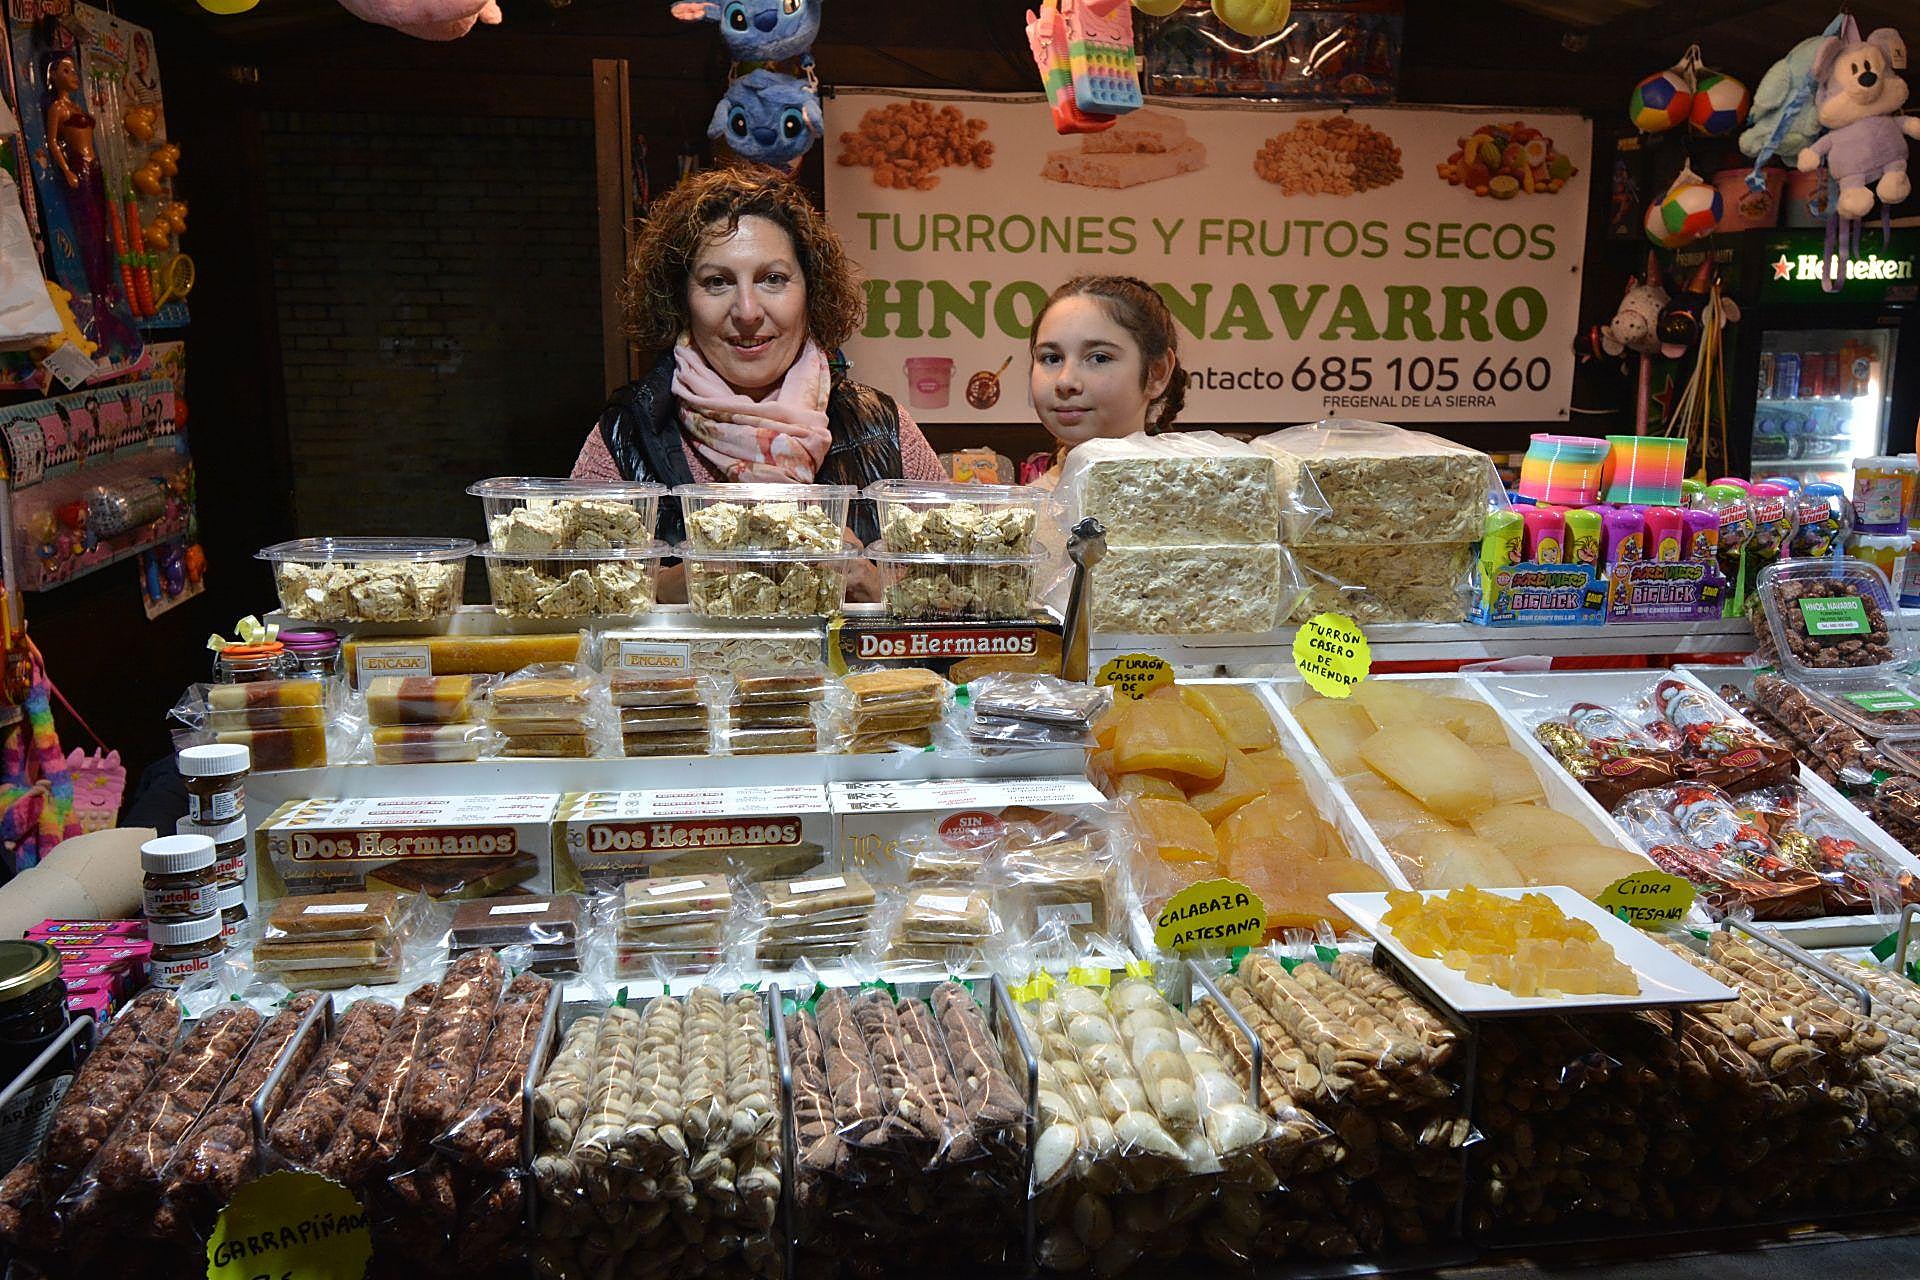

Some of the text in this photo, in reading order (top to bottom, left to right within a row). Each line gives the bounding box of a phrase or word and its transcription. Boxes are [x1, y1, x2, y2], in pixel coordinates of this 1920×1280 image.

[857, 212, 1556, 261] TURRONES Y FRUTOS SECOS
[860, 279, 1050, 339] HNO
[1186, 356, 1551, 392] ntacto 685 105 660
[1323, 395, 1496, 408] FREGENAL DE LA SIERRA
[1511, 571, 1588, 589] SCREAMERS
[1827, 601, 1858, 610] NAVARRO
[1309, 621, 1360, 644] TURRÓN
[860, 634, 1034, 657] Dos Hermanos
[1309, 638, 1354, 659] CASERO
[367, 658, 420, 669] ENCASA
[631, 656, 678, 667] ENCASA
[1114, 659, 1164, 670] TURRÓN
[1317, 655, 1332, 667] DE
[1107, 672, 1155, 682] CASERO
[1300, 659, 1359, 686] ALMENDRA
[1122, 683, 1138, 691] DE
[959, 816, 982, 827] SIN
[294, 831, 513, 859] Dos Hermanos
[592, 824, 796, 852] Dos Hermanos
[214, 856, 244, 874] utella
[155, 887, 199, 903] nutella
[1158, 893, 1250, 928] CALABAZA
[1172, 917, 1261, 947] ARTESANA
[164, 958, 209, 974] nutella
[3, 1089, 60, 1127] ARROPE
